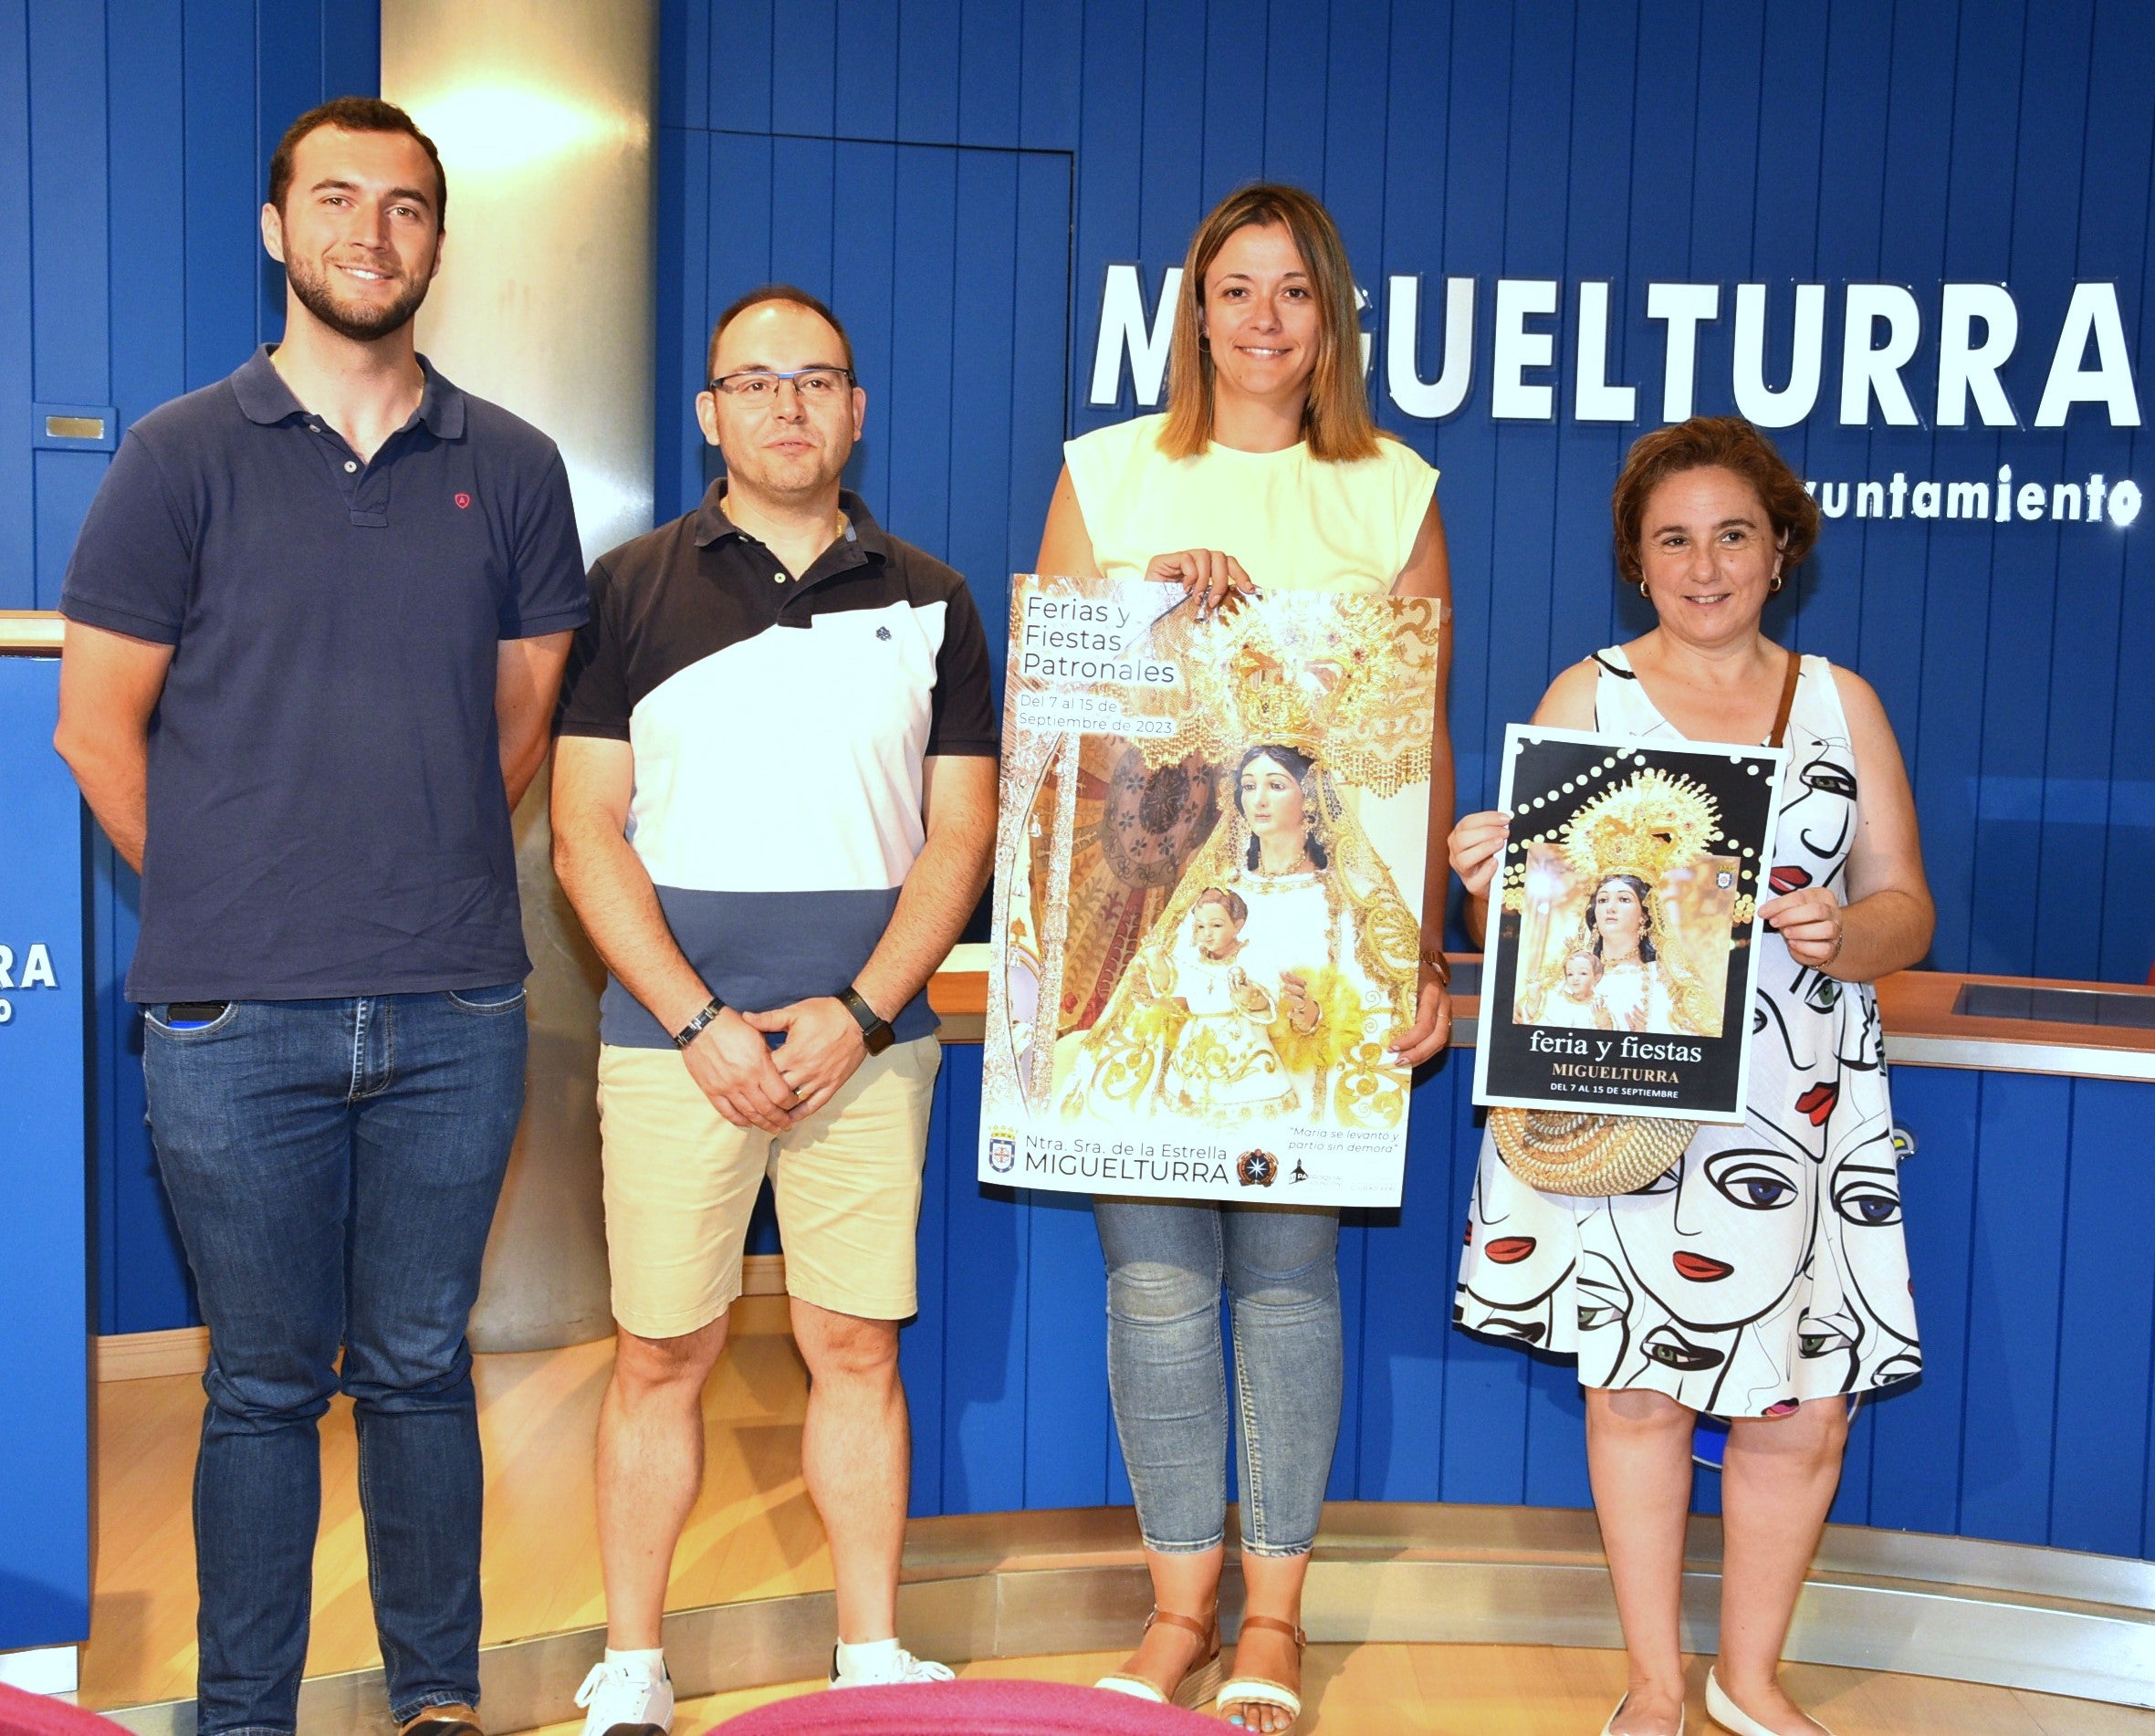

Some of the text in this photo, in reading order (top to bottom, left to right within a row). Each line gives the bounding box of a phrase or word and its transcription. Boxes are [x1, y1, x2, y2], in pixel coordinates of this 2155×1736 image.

[1090, 264, 2141, 428] MUELTURRA
[1028, 596, 1131, 629] Ferias y
[1026, 624, 1122, 652] Fiestas
[1024, 653, 1175, 684] Patronales
[1020, 694, 1117, 713] Del 7 al 15 de
[1019, 712, 1173, 734] Septiembre de 2023
[1529, 1030, 1702, 1063] feria y fiestas
[1552, 1062, 1679, 1084] MIGUELTURRA
[1550, 1082, 1679, 1099] DEL 7 AL 15 DE SEPTIEMBRE
[1026, 1135, 1228, 1161] Ntra. Sra. de la Estrella
[1327, 1143, 1344, 1152] sin
[1331, 1131, 1344, 1139] se
[1391, 1133, 1399, 1143] y
[1025, 1151, 1229, 1185] MIGUELTURRA
